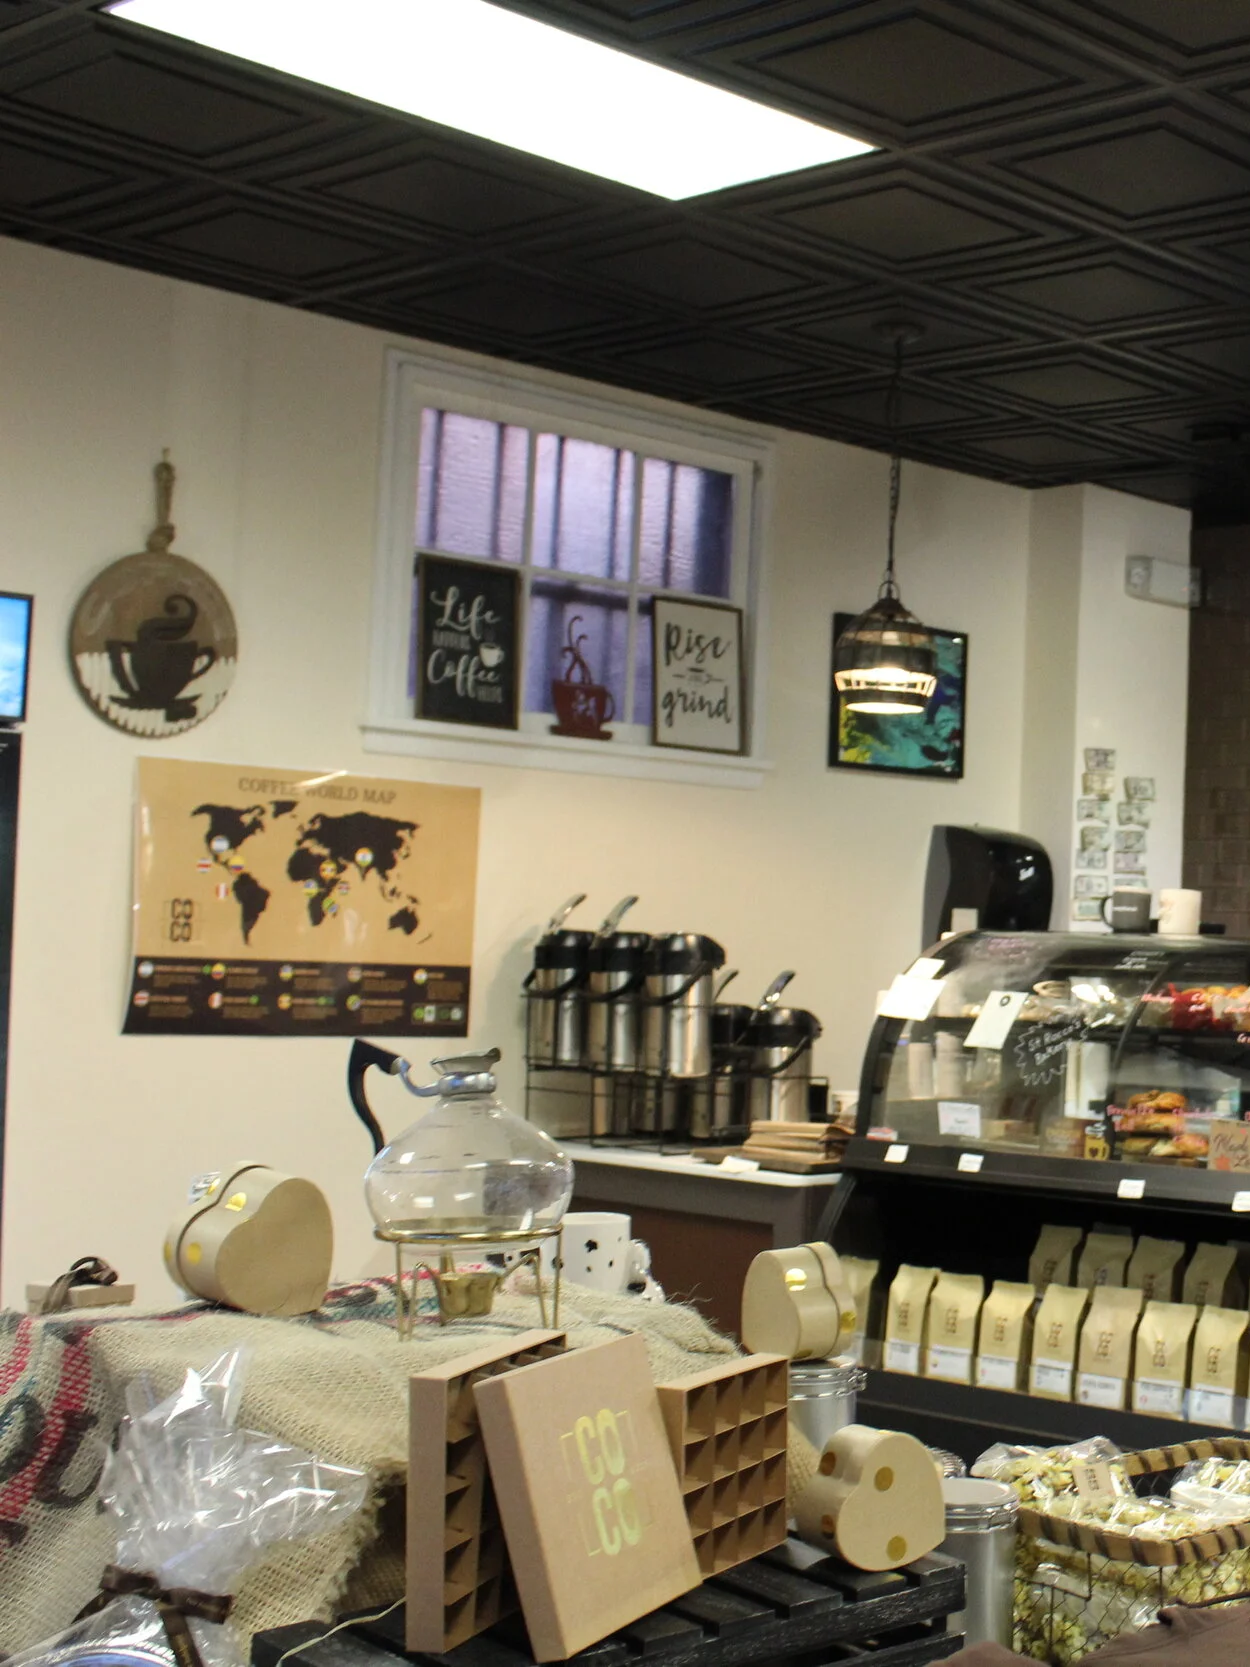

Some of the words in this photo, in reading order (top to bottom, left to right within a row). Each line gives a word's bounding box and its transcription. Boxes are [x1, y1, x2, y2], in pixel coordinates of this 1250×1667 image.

[430, 586, 502, 640] Life
[664, 621, 732, 666] Rise
[427, 649, 501, 698] Coffee
[661, 685, 732, 728] grind
[238, 777, 299, 796] COFFEE
[304, 785, 358, 801] WORLD
[362, 788, 397, 805] MAP
[574, 1408, 626, 1486] CO
[592, 1477, 643, 1556] CO
